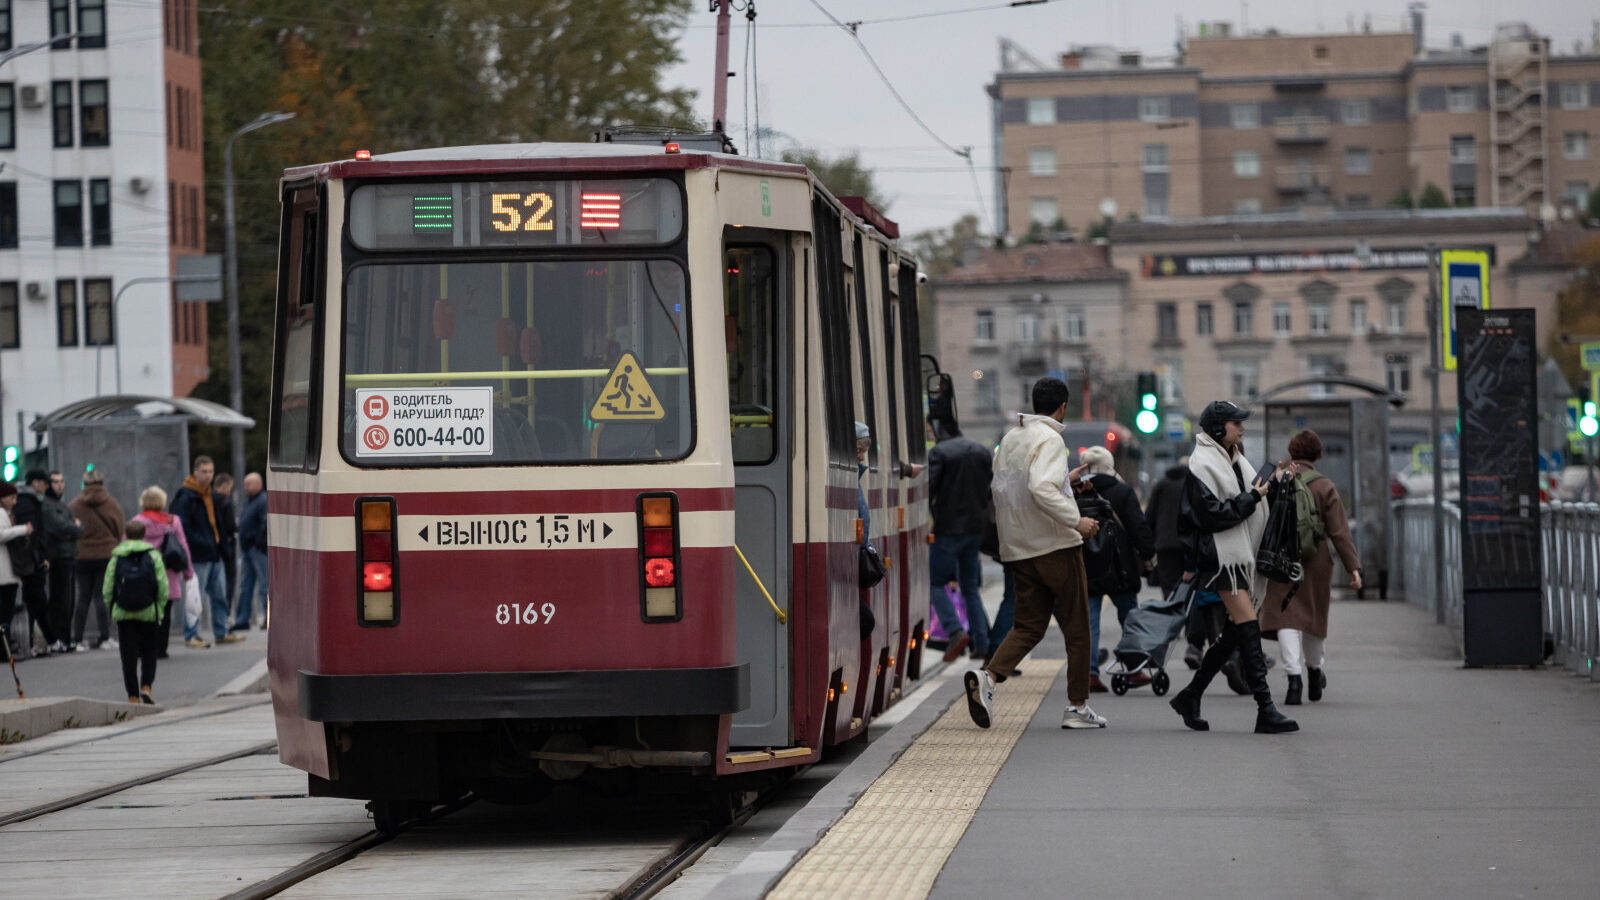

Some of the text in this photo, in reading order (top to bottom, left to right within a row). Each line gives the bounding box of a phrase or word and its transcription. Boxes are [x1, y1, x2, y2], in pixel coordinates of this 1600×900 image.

[492, 193, 554, 231] 52
[393, 395, 453, 407] ВОДИТЕЛЬ
[393, 408, 485, 421] НАРУШИЛ ПДД?
[393, 427, 485, 447] 600-44-00
[437, 515, 595, 548] ВЫНОС 1,5 М
[495, 602, 556, 625] 8169
